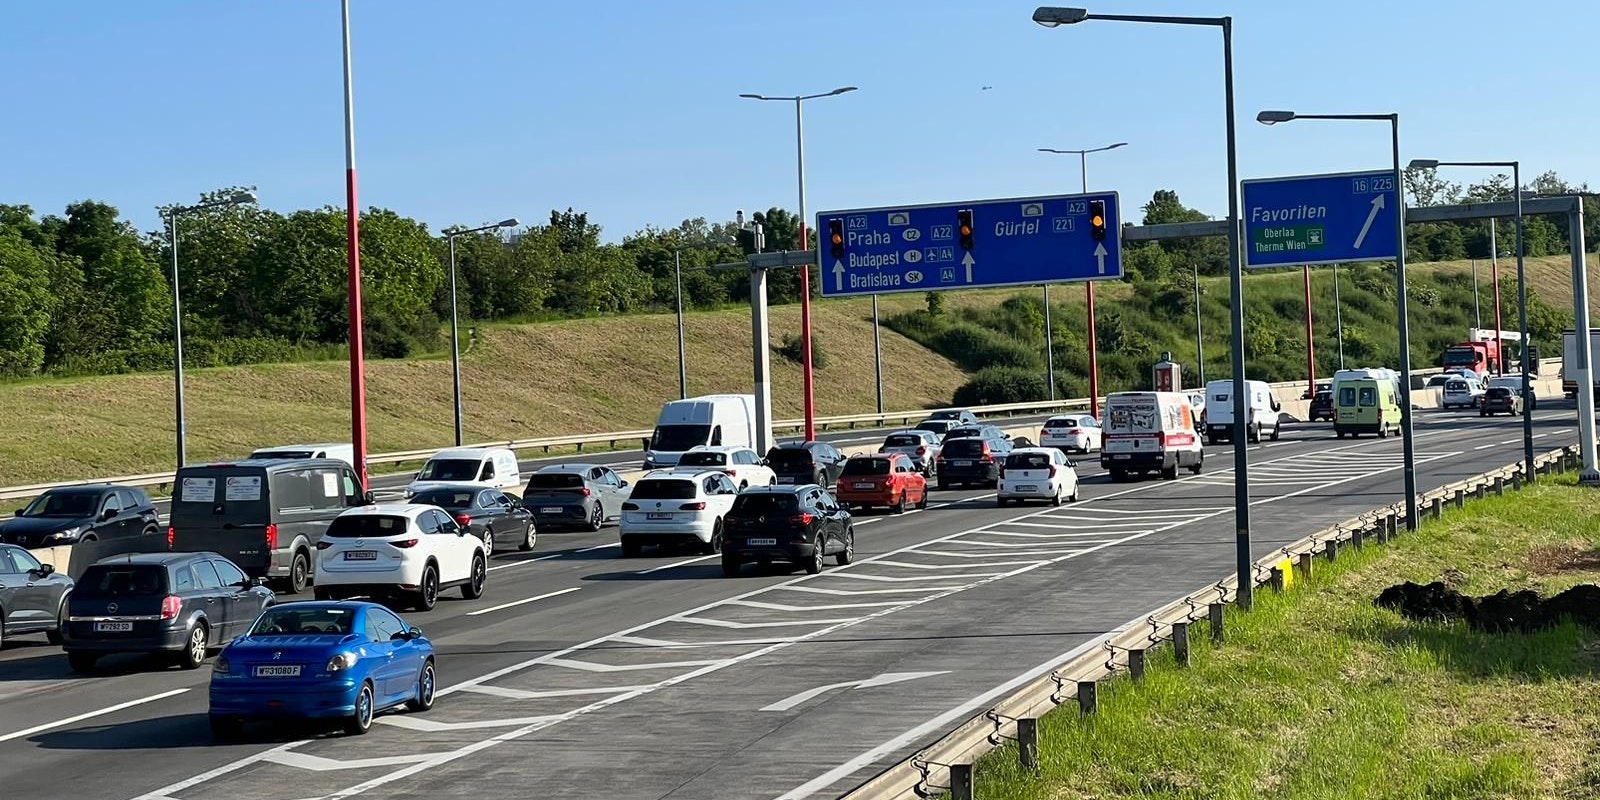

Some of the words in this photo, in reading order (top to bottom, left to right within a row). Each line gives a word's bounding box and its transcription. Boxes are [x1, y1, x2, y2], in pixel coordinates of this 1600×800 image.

[1354, 181, 1366, 191] 16
[1373, 178, 1392, 190] 225
[1070, 202, 1086, 214] A23
[1252, 204, 1327, 222] Favoriten
[849, 217, 866, 228] A23
[995, 219, 1040, 237] Gürtel
[1055, 218, 1073, 230] 221
[848, 230, 891, 246] Praha
[906, 230, 917, 239] CZ
[933, 227, 951, 238] A22
[1264, 227, 1295, 238] Oberlaa
[1255, 242, 1284, 253] Therme
[1286, 240, 1306, 250] Wien
[849, 250, 900, 269] Budapest
[941, 248, 952, 259] A4
[850, 271, 901, 288] Bratislava
[908, 272, 920, 281] SK
[942, 269, 953, 280] A4
